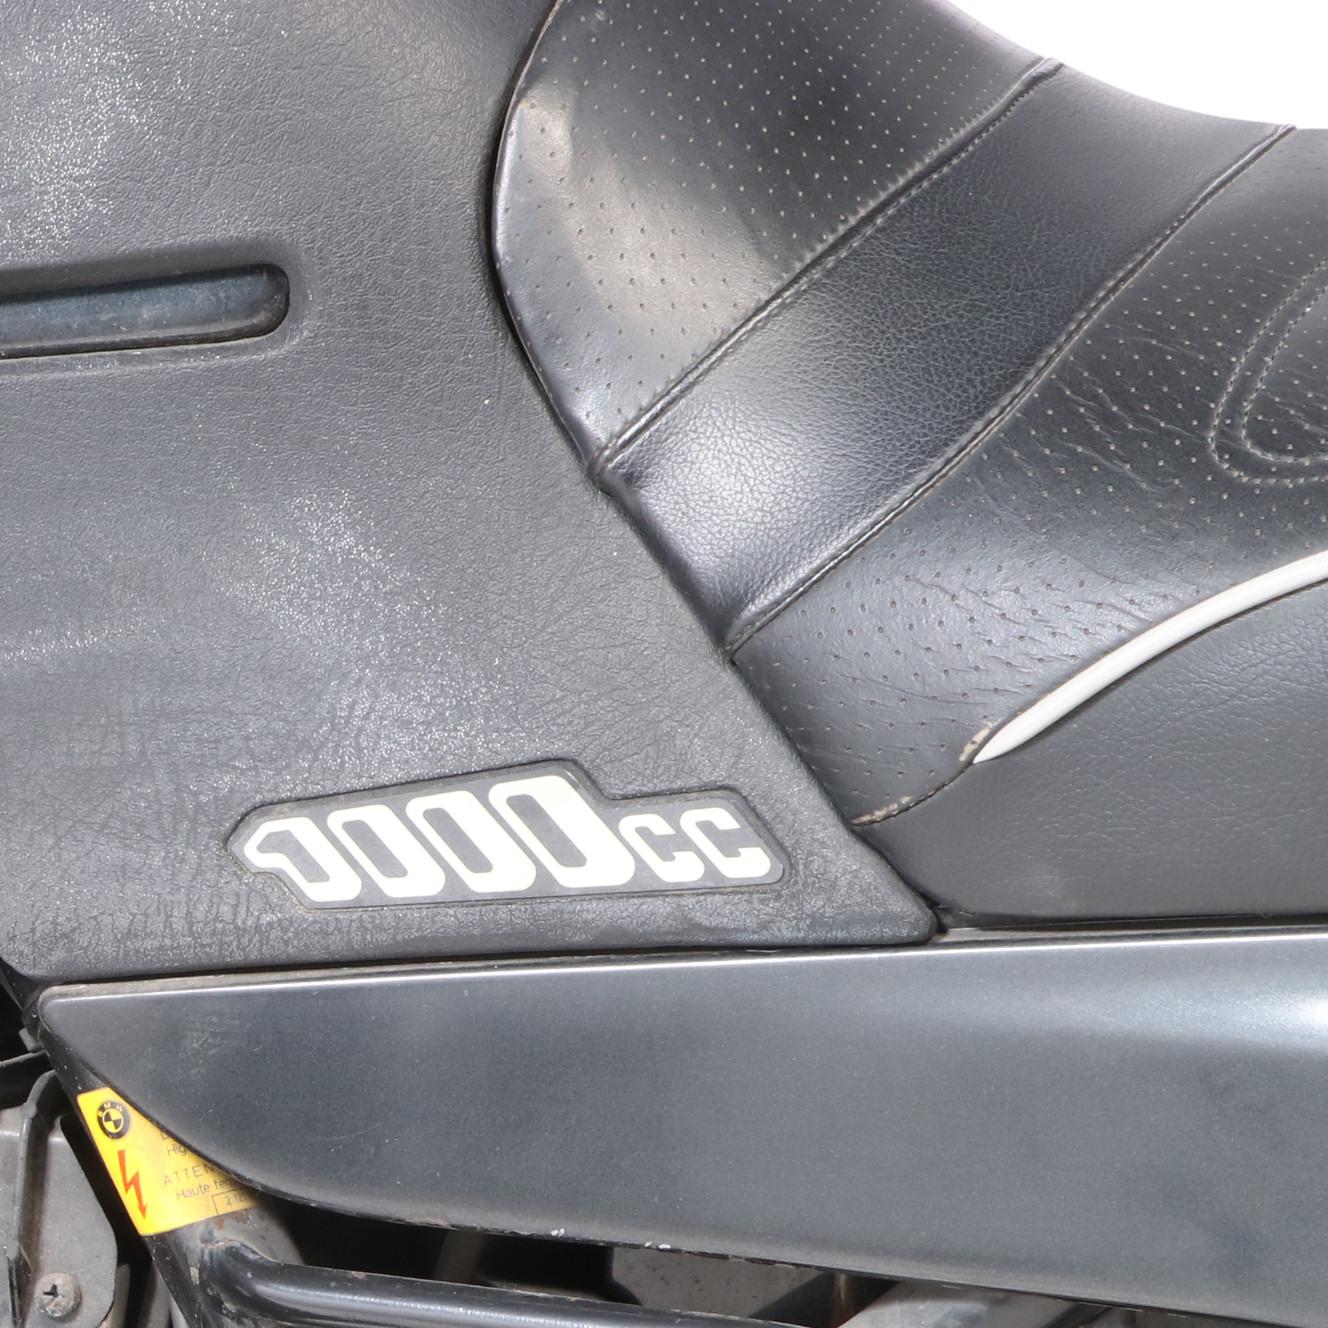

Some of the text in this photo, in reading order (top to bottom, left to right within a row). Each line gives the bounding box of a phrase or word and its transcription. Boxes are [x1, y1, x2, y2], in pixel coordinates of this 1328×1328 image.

[167, 1143, 188, 1156] Hig
[164, 1163, 215, 1184] ATTEN
[176, 1184, 210, 1200] Haute
